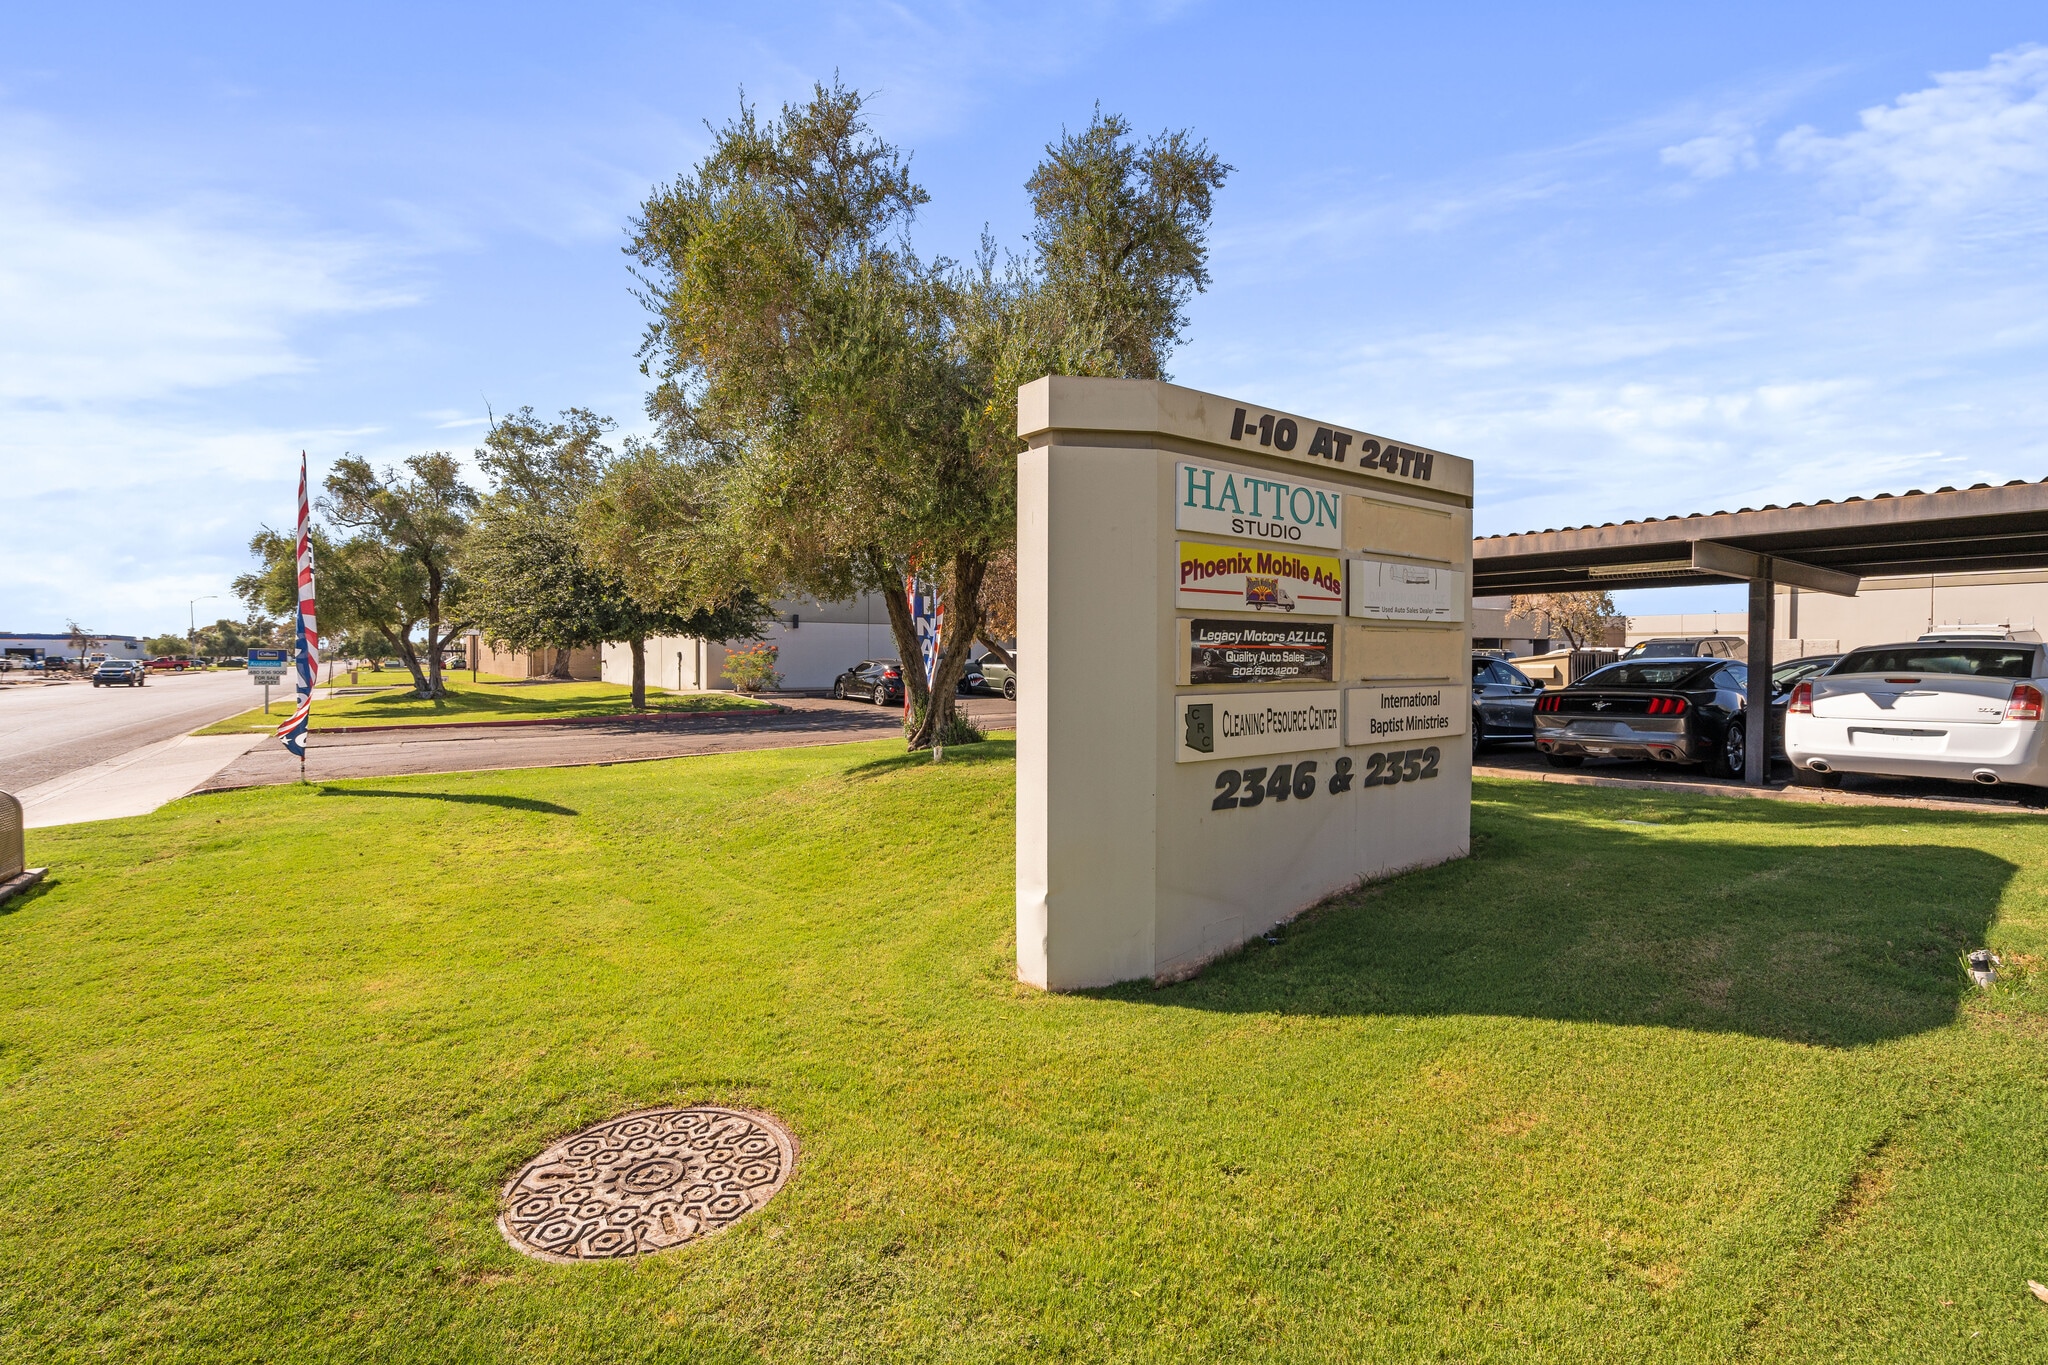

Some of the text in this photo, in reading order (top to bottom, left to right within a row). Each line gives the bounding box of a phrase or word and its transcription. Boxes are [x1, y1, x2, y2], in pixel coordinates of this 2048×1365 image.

[1230, 407, 1434, 481] I-10 AT 24TH
[1184, 466, 1340, 529] HATTON
[1232, 518, 1302, 541] STUDIO
[1181, 552, 1252, 585] Phoenix
[1256, 553, 1310, 581] Mobile
[1313, 566, 1341, 595] Ads
[1420, 607, 1434, 615] Dealer
[1200, 629, 1327, 644] Legacy Motors AZ LLC.
[1226, 650, 1305, 665] Quality Auto Sales
[1232, 666, 1299, 676] 602.603.1200
[1381, 690, 1440, 709] International
[1222, 710, 1265, 737] CLEANING
[1309, 705, 1338, 731] CENTER
[1370, 714, 1449, 737] Baptist Ministries
[1211, 746, 1440, 811] 2346 & 2352
